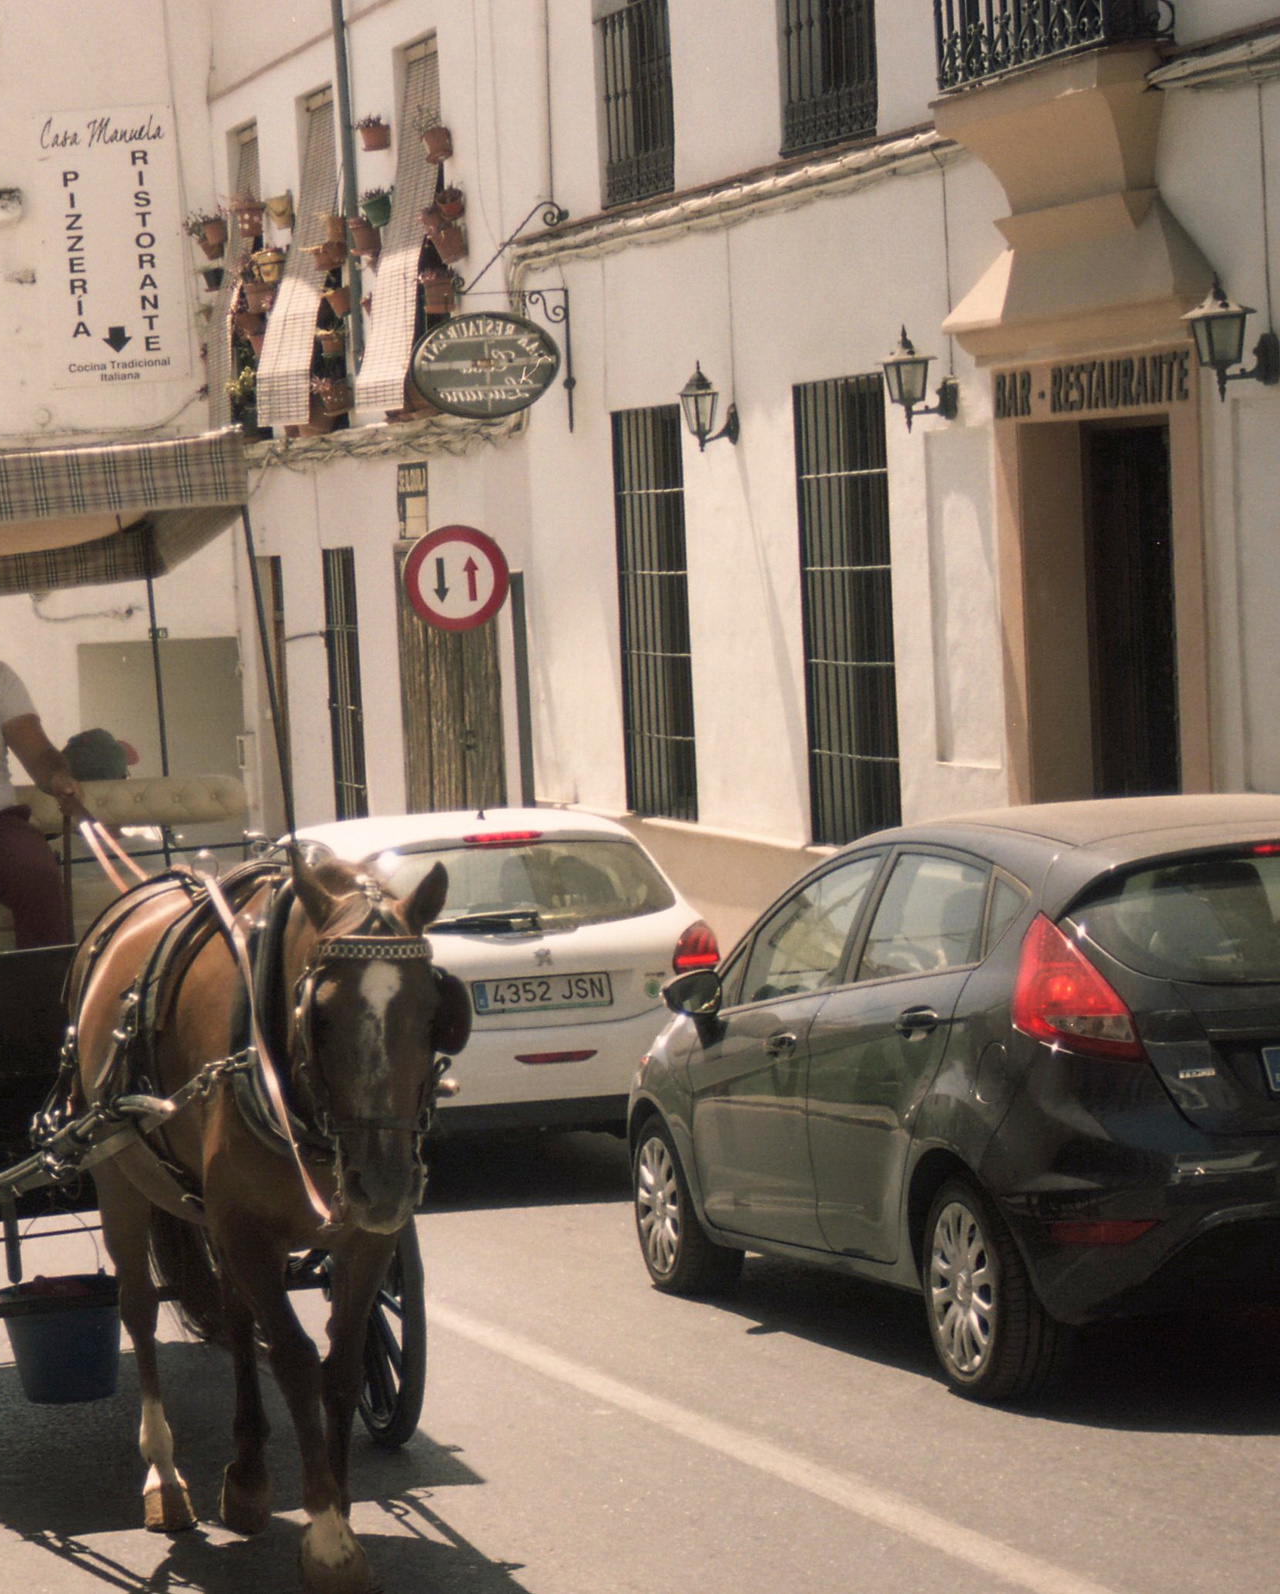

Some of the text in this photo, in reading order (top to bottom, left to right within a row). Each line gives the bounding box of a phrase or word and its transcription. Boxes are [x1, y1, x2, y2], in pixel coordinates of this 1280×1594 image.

[40, 114, 166, 149] Casa Manuela
[62, 171, 92, 338] PIZZERÍA
[130, 150, 161, 352] RISTORANTE
[68, 357, 171, 373] Cocina Tradicional
[100, 372, 140, 382] Italiana
[995, 350, 1189, 419] BAR RESTAURANTE
[493, 978, 605, 1005] 4352 JSN
